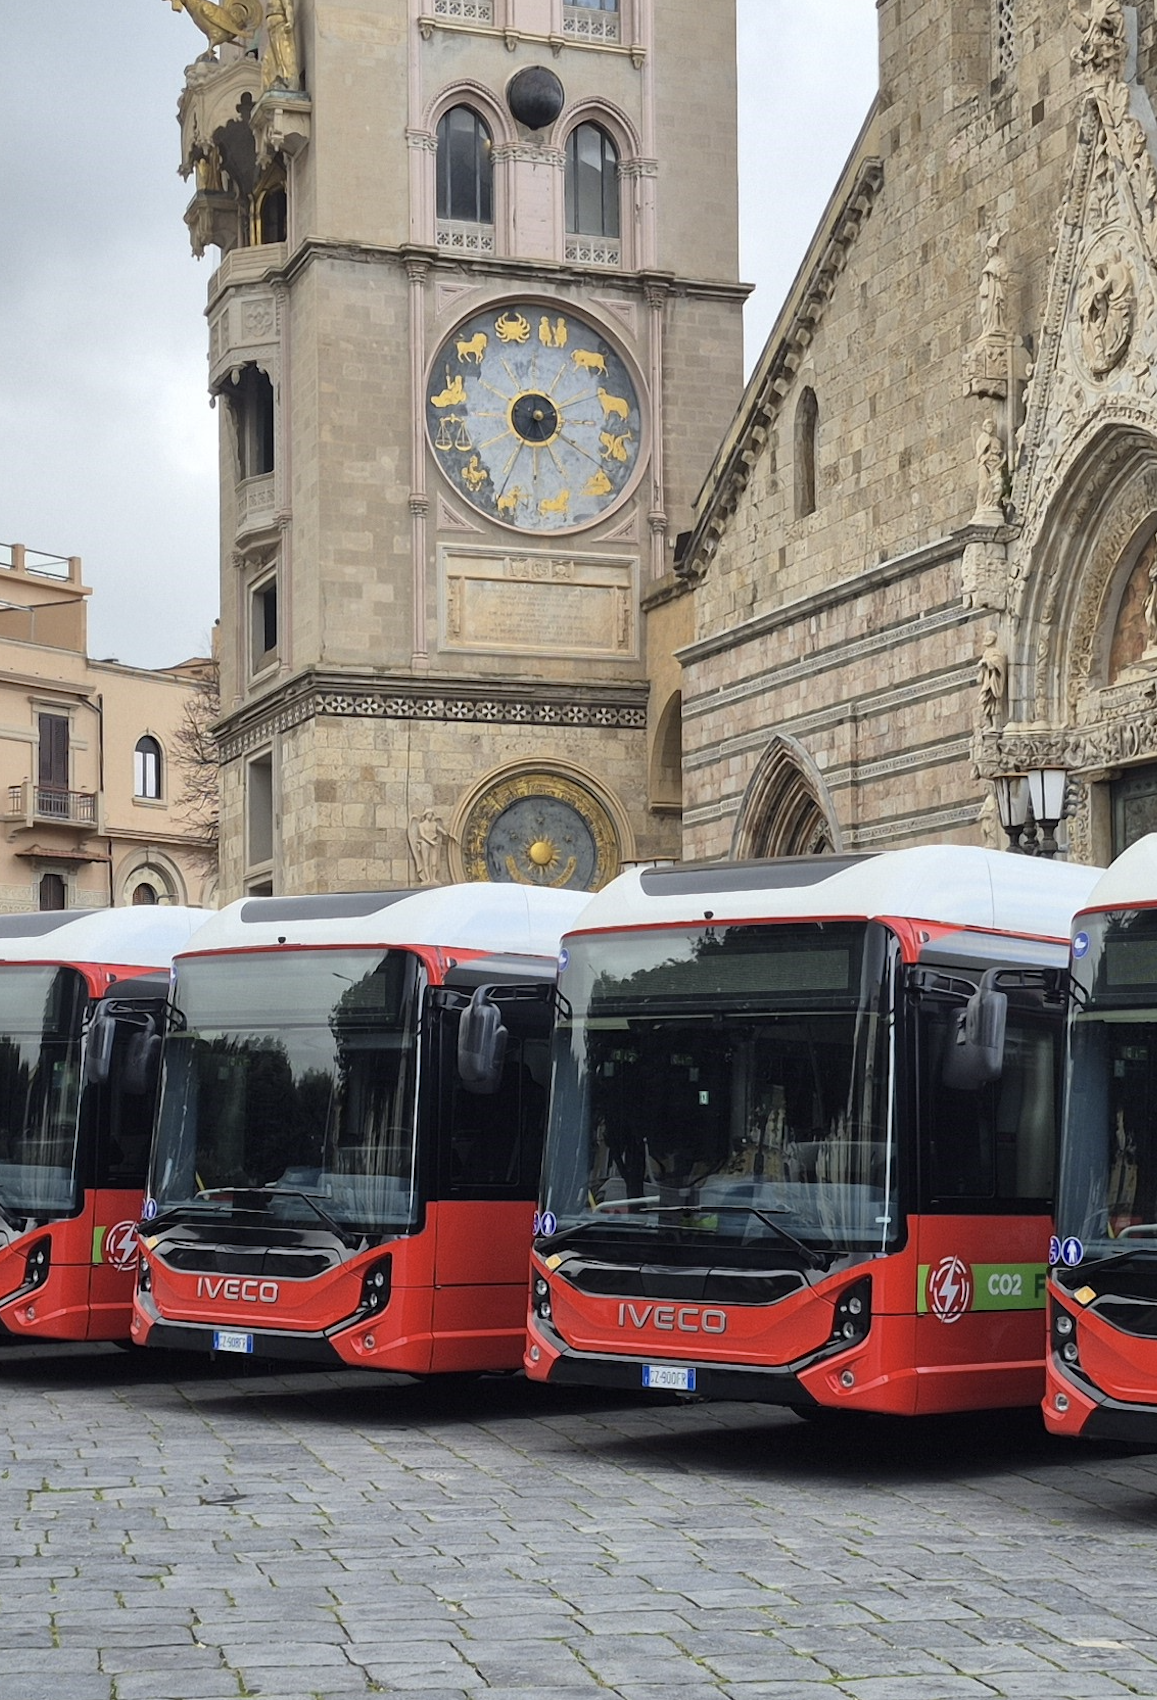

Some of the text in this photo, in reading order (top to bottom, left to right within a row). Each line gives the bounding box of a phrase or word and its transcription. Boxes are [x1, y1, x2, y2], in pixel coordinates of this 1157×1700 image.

[197, 1276, 279, 1303] IVECO
[987, 1273, 1022, 1296] CO2
[618, 1302, 727, 1334] IVECO
